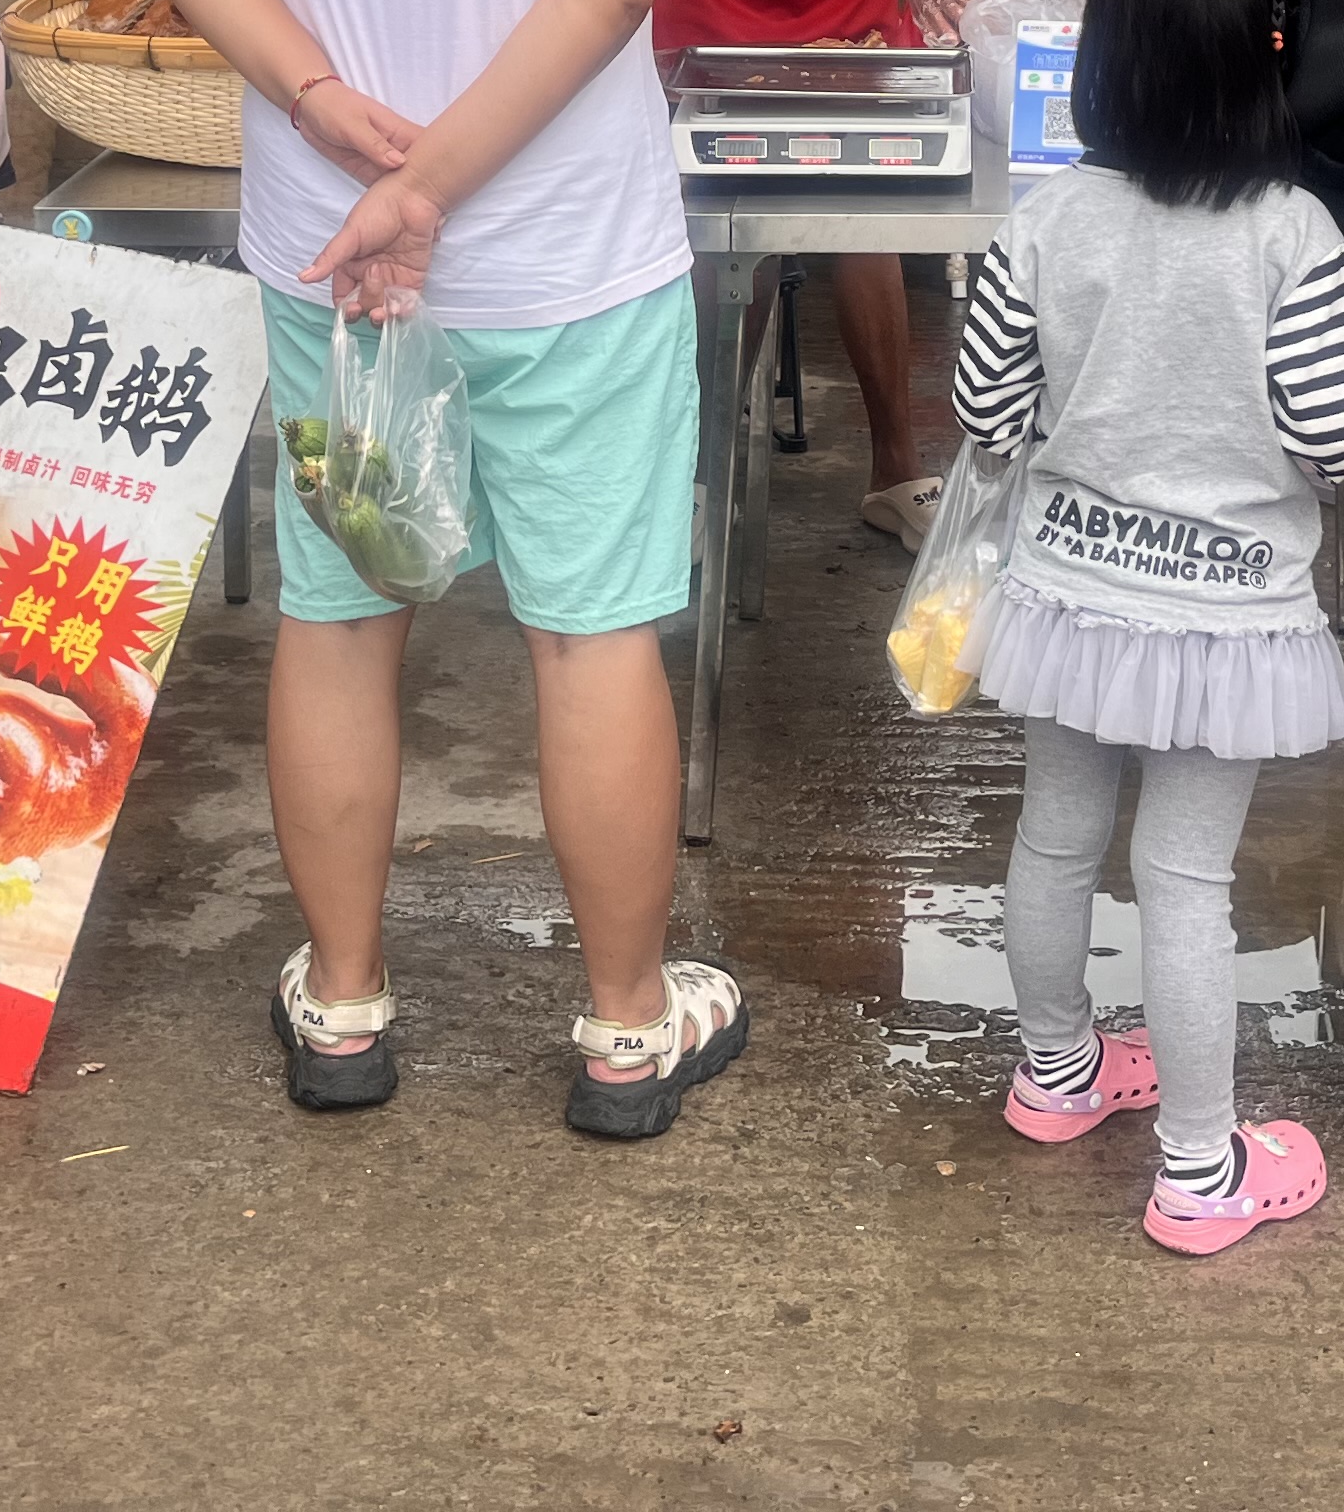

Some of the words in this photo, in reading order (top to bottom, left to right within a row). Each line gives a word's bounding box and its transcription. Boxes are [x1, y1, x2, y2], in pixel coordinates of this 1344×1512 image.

[70, 465, 158, 504] 回味无穷
[29, 536, 133, 616] 只用
[1035, 524, 1060, 547] BY
[1089, 542, 1198, 582] BATHING
[2, 585, 104, 676] 鲜鹅
[302, 1009, 325, 1027] FILA
[613, 1037, 644, 1051] FILA
